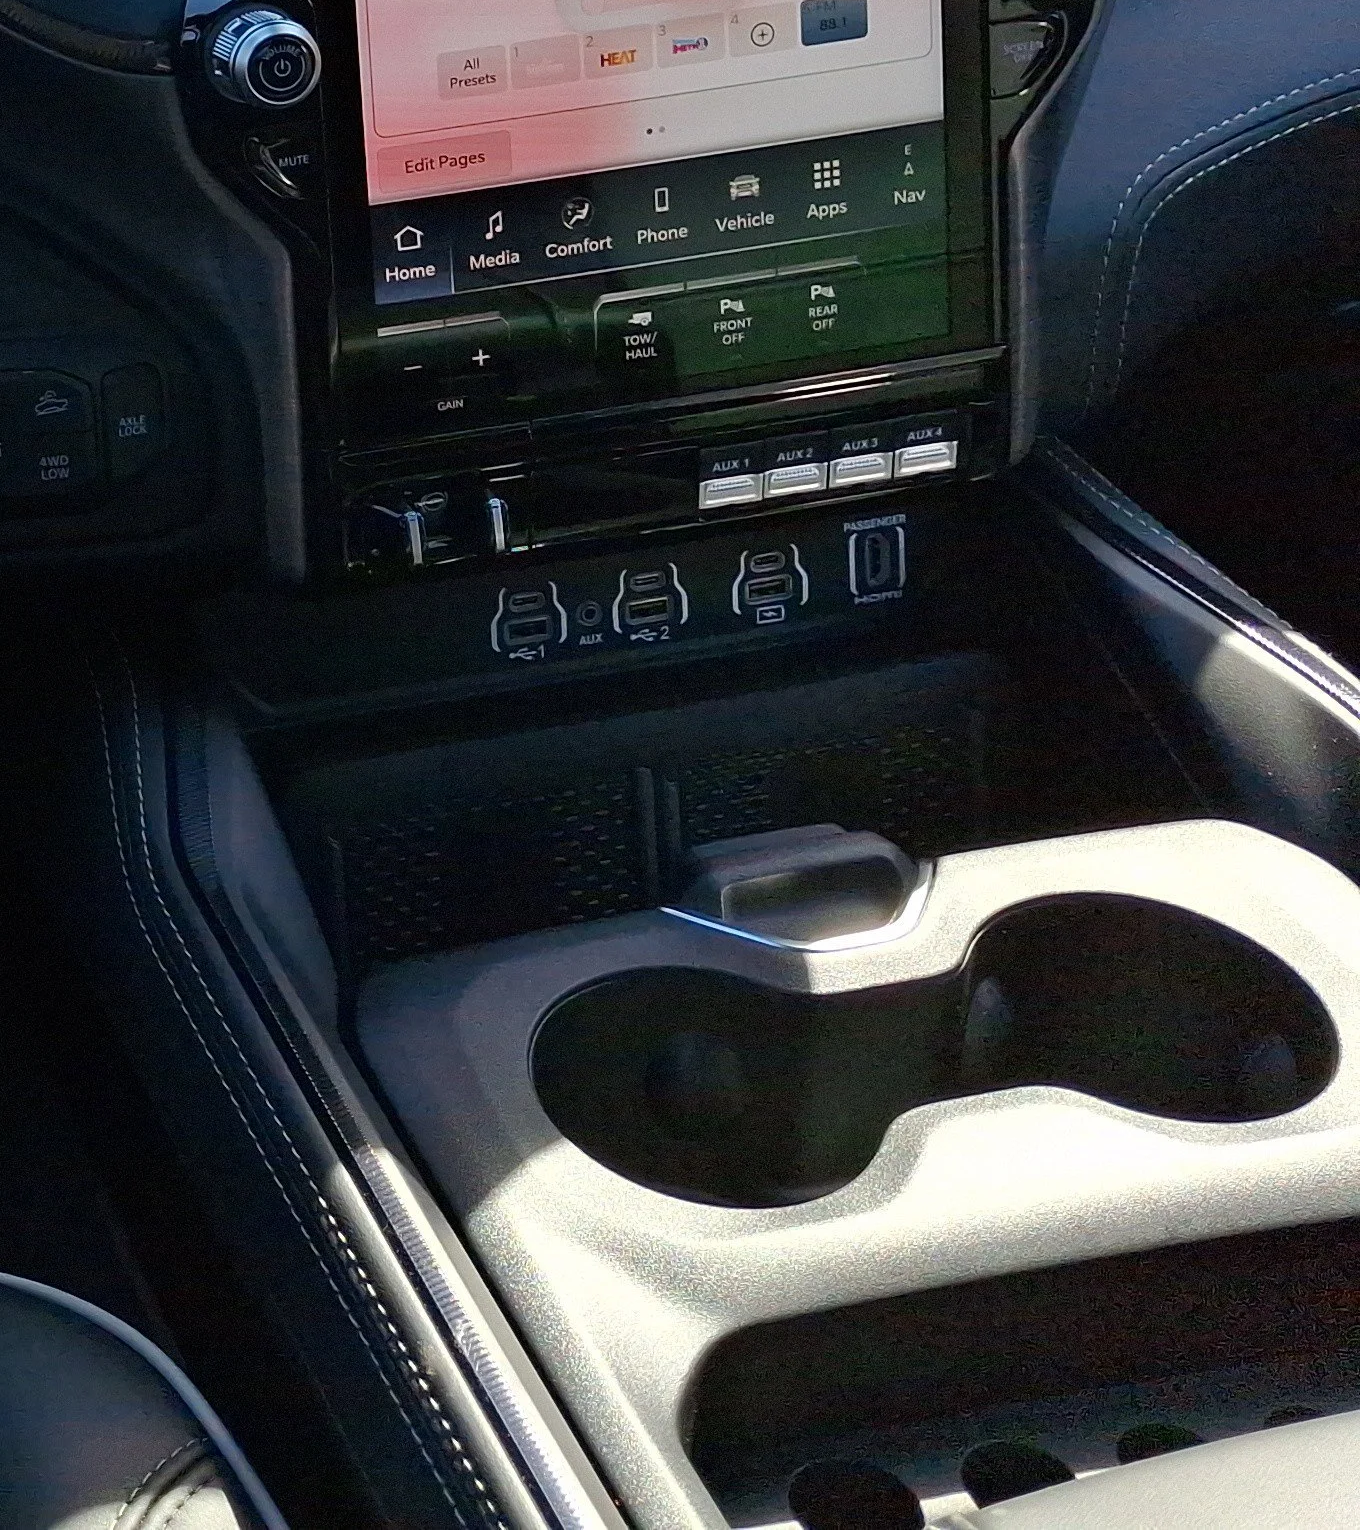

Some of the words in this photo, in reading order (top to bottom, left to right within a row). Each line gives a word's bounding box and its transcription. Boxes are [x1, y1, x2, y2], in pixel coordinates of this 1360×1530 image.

[657, 24, 667, 37] 3
[585, 36, 594, 48] 2
[464, 58, 479, 71] All
[600, 49, 637, 68] HEAT
[450, 73, 497, 89] Presets
[904, 144, 911, 156] E
[279, 152, 310, 167] MUTE
[404, 152, 436, 174] Edit
[438, 148, 486, 171] Pages
[893, 186, 925, 206] Nav
[806, 198, 847, 221] Apps
[715, 209, 775, 234] Vehicle
[637, 222, 688, 245] Phone
[545, 234, 613, 260] Comfort
[469, 247, 520, 271] Media
[385, 262, 435, 283] Home
[808, 303, 838, 317] REAR
[713, 317, 753, 333] FRONT
[812, 317, 836, 331] OFF
[623, 330, 657, 347] TOW/
[722, 331, 745, 346] OFF
[625, 345, 658, 360] HAUL
[437, 397, 464, 412] GAIN
[120, 415, 146, 427] AXLE
[119, 425, 147, 437] LOCK
[906, 428, 933, 441] AUX
[934, 427, 942, 437] 4
[842, 439, 869, 451] AUX
[871, 437, 879, 448] 3
[40, 455, 69, 467] 4WD
[777, 449, 804, 462] AUX
[806, 447, 814, 458] 2
[712, 459, 739, 472] AUX
[745, 458, 750, 468] 1
[41, 468, 70, 480] LOW
[579, 633, 603, 645] AUX
[660, 625, 670, 640] 2
[538, 644, 545, 658] 1
